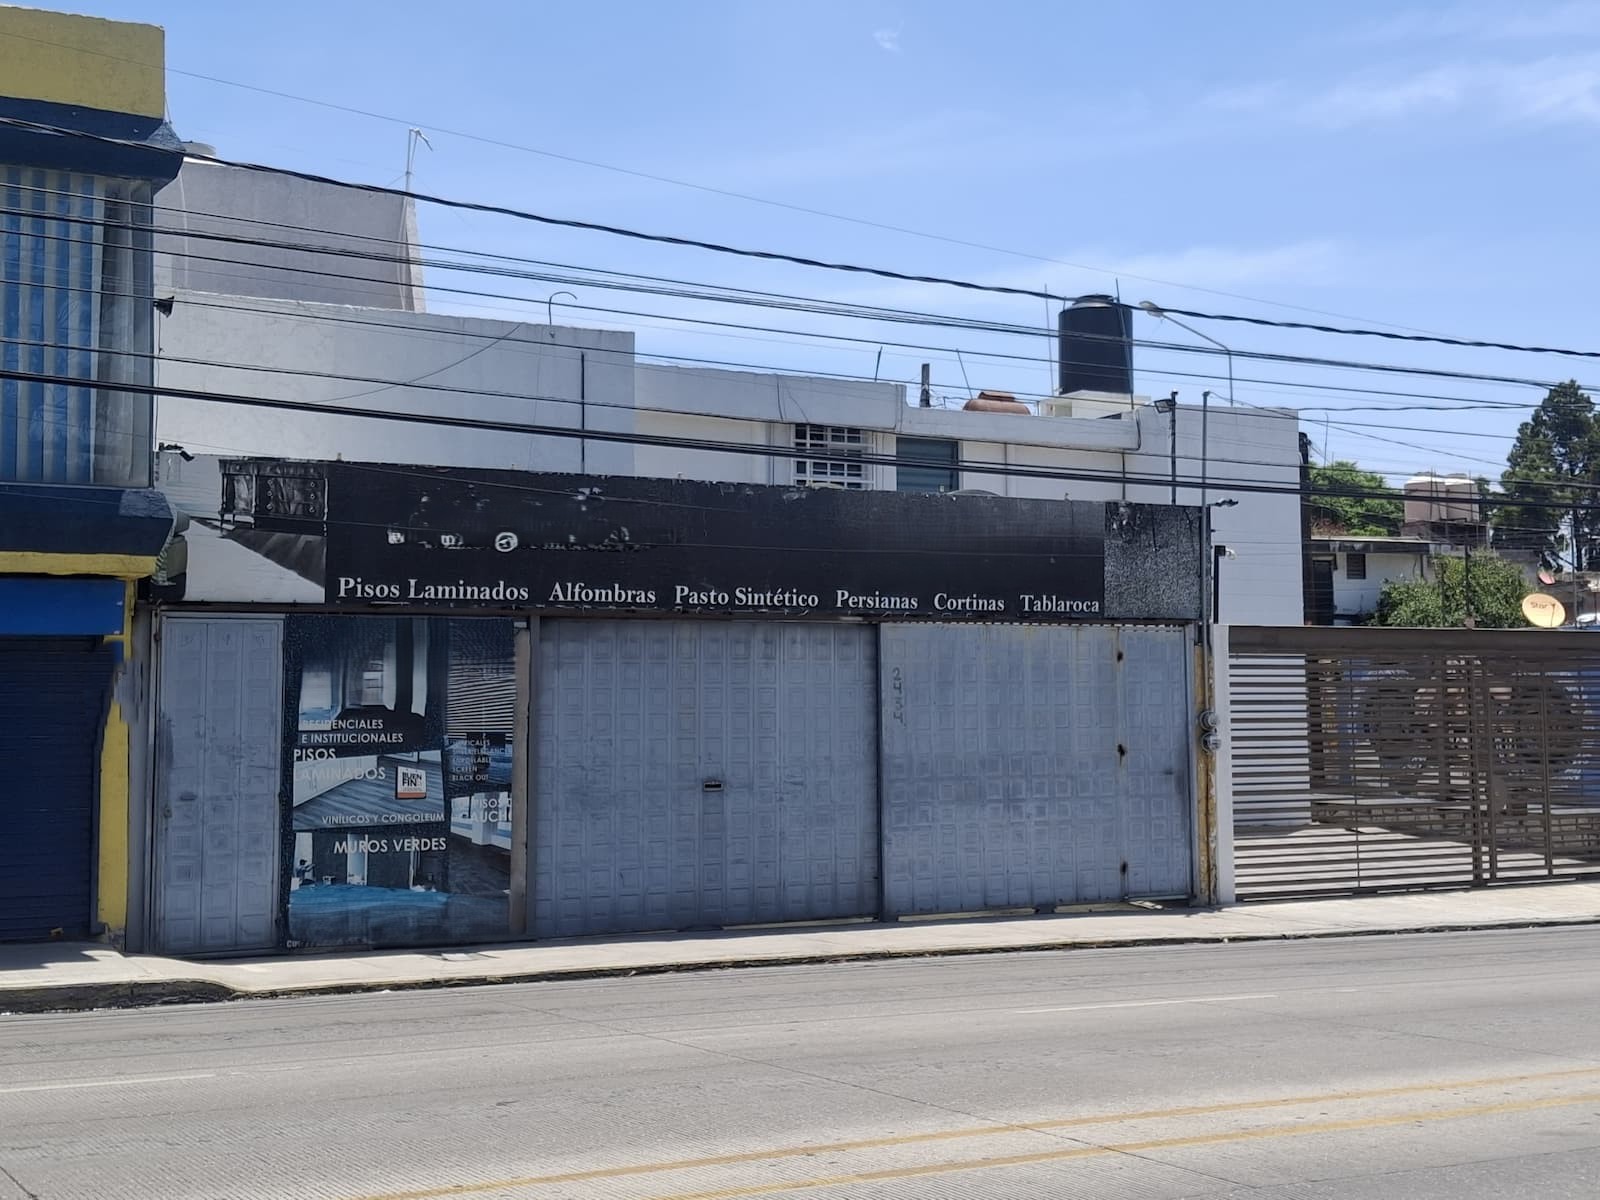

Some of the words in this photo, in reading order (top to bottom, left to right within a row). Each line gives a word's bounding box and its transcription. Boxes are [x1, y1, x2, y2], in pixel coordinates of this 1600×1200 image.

[338, 576, 400, 600] Pisos
[407, 579, 529, 602] Laminados
[548, 582, 656, 604] Alfombras
[675, 584, 729, 606] Pasto
[734, 586, 819, 608] Sintético
[836, 590, 918, 611] Persianas
[934, 593, 1005, 612] Cortinas
[1020, 594, 1100, 614] Tablaroca
[301, 734, 308, 744] E
[311, 733, 404, 744] INSTITUCIONALES
[293, 748, 337, 762] PISOS
[402, 779, 417, 787] FIN
[381, 813, 445, 823] CONGOLEUM
[333, 839, 389, 854] MUROS
[393, 838, 447, 852] VERDES
